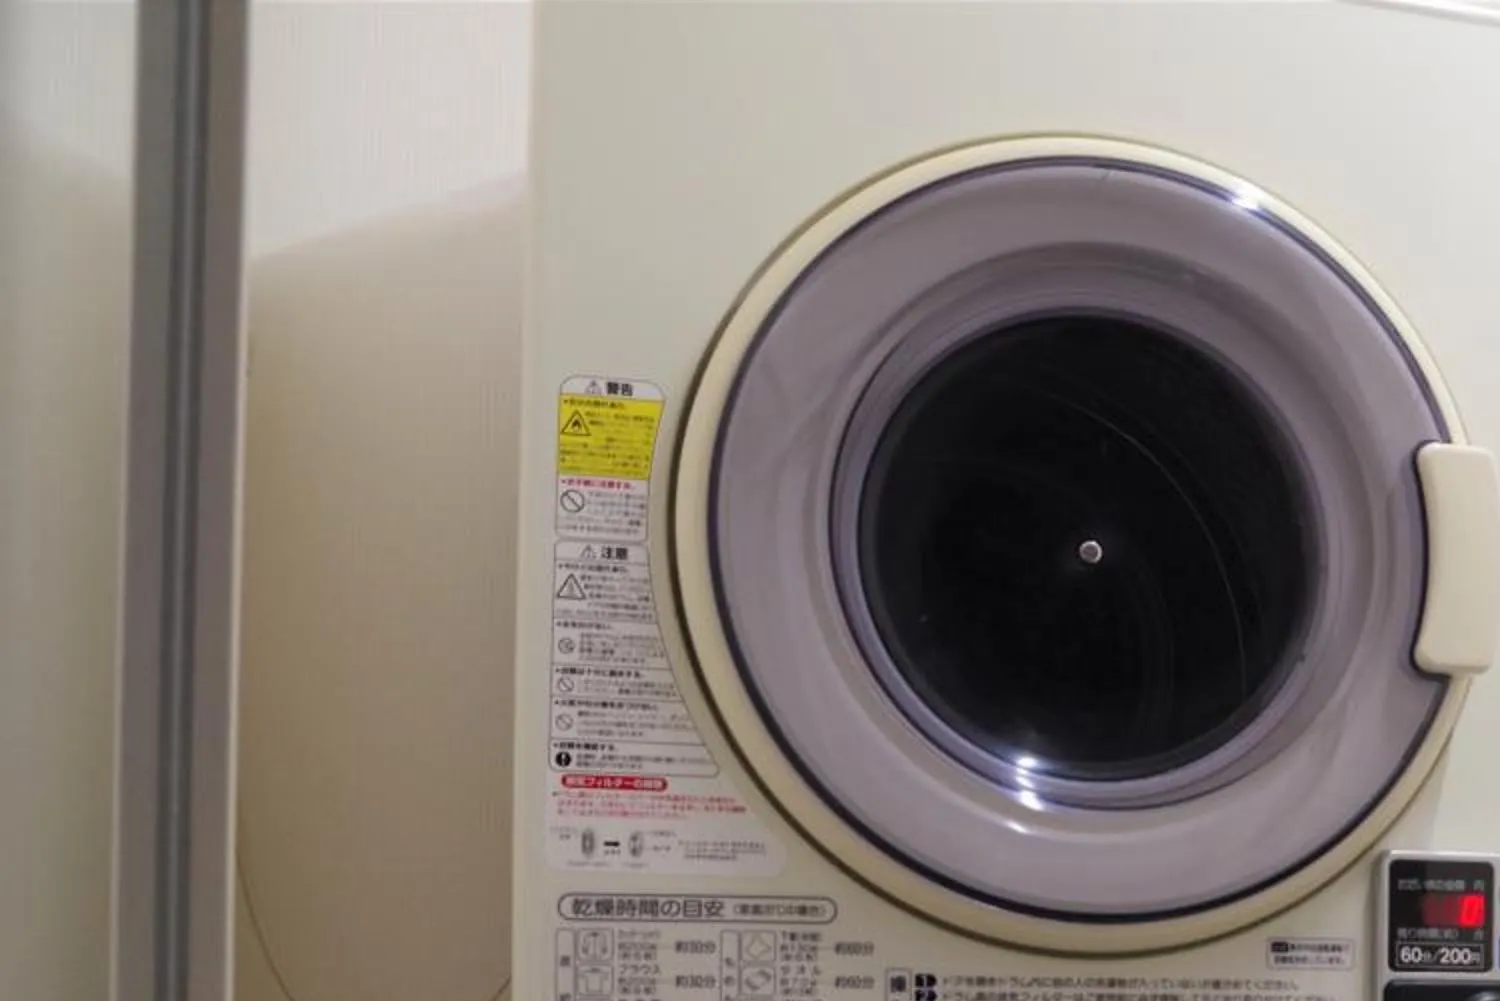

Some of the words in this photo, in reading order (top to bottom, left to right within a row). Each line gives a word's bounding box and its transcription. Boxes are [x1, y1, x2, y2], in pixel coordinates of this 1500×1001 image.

[607, 381, 634, 397] 警告
[571, 898, 725, 919] 乾燥時間の目安
[1461, 894, 1485, 928] 0
